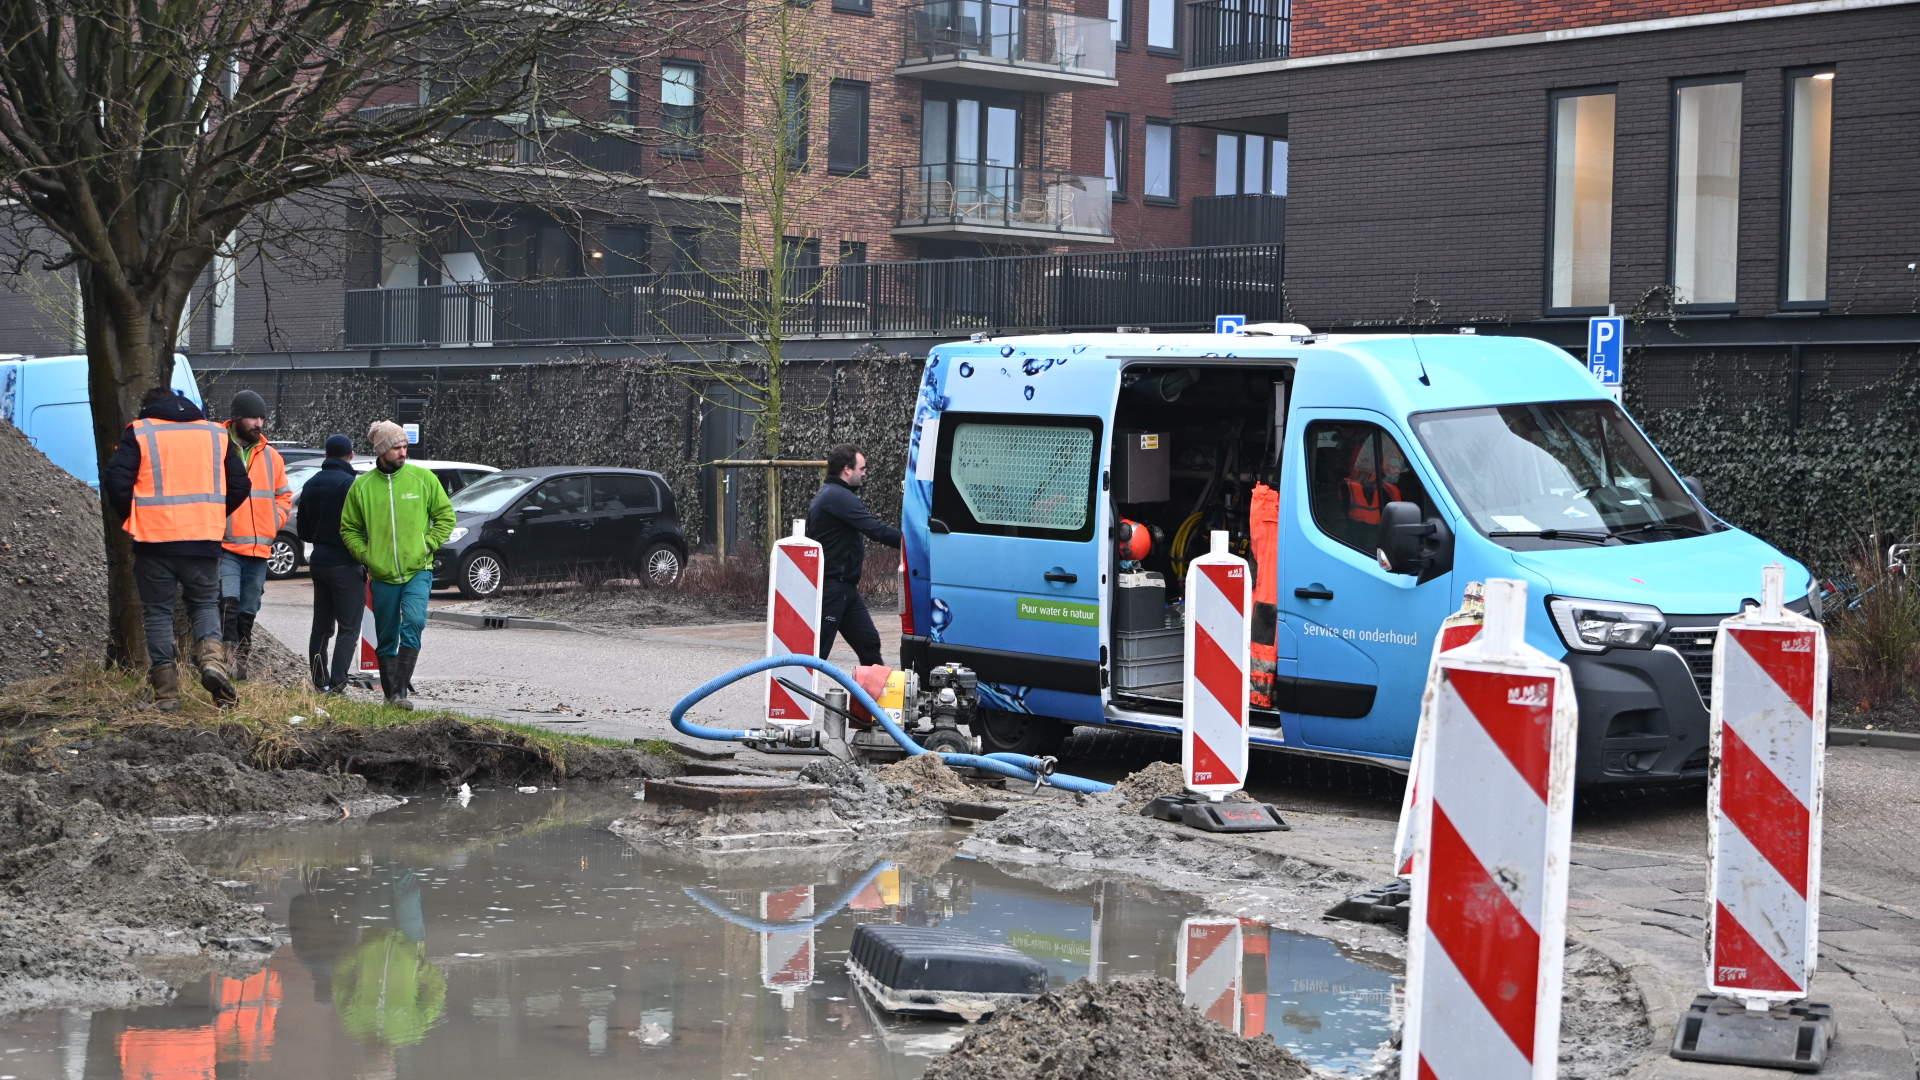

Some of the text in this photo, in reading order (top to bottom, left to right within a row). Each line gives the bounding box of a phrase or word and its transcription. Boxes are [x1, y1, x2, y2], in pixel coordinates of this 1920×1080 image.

[1597, 322, 1614, 353] P
[1021, 603, 1095, 620] Puur water & natuur
[1303, 622, 1417, 646] Service en onderhoud
